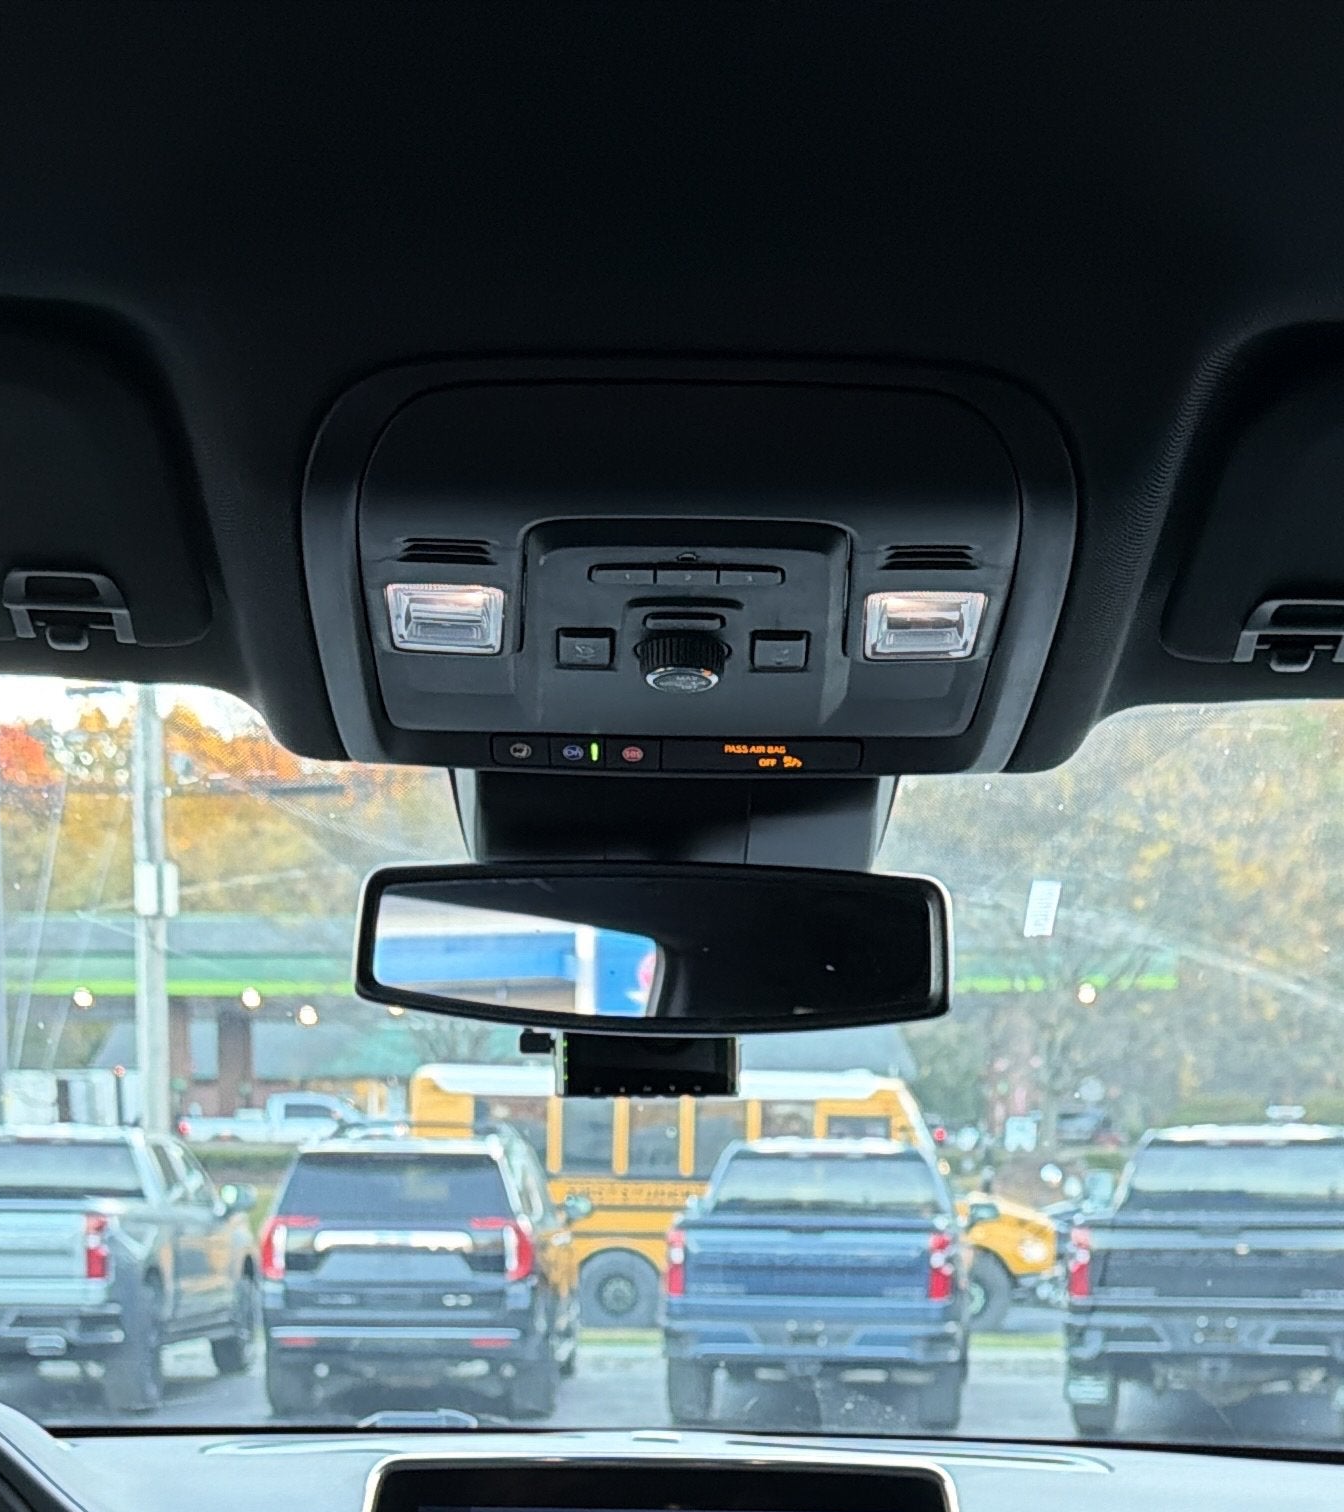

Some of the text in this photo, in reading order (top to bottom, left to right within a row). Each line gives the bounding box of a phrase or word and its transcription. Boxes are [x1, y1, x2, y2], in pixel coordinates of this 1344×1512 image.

[723, 744, 786, 755] PASS AIR BAG
[758, 757, 778, 768] OFF
